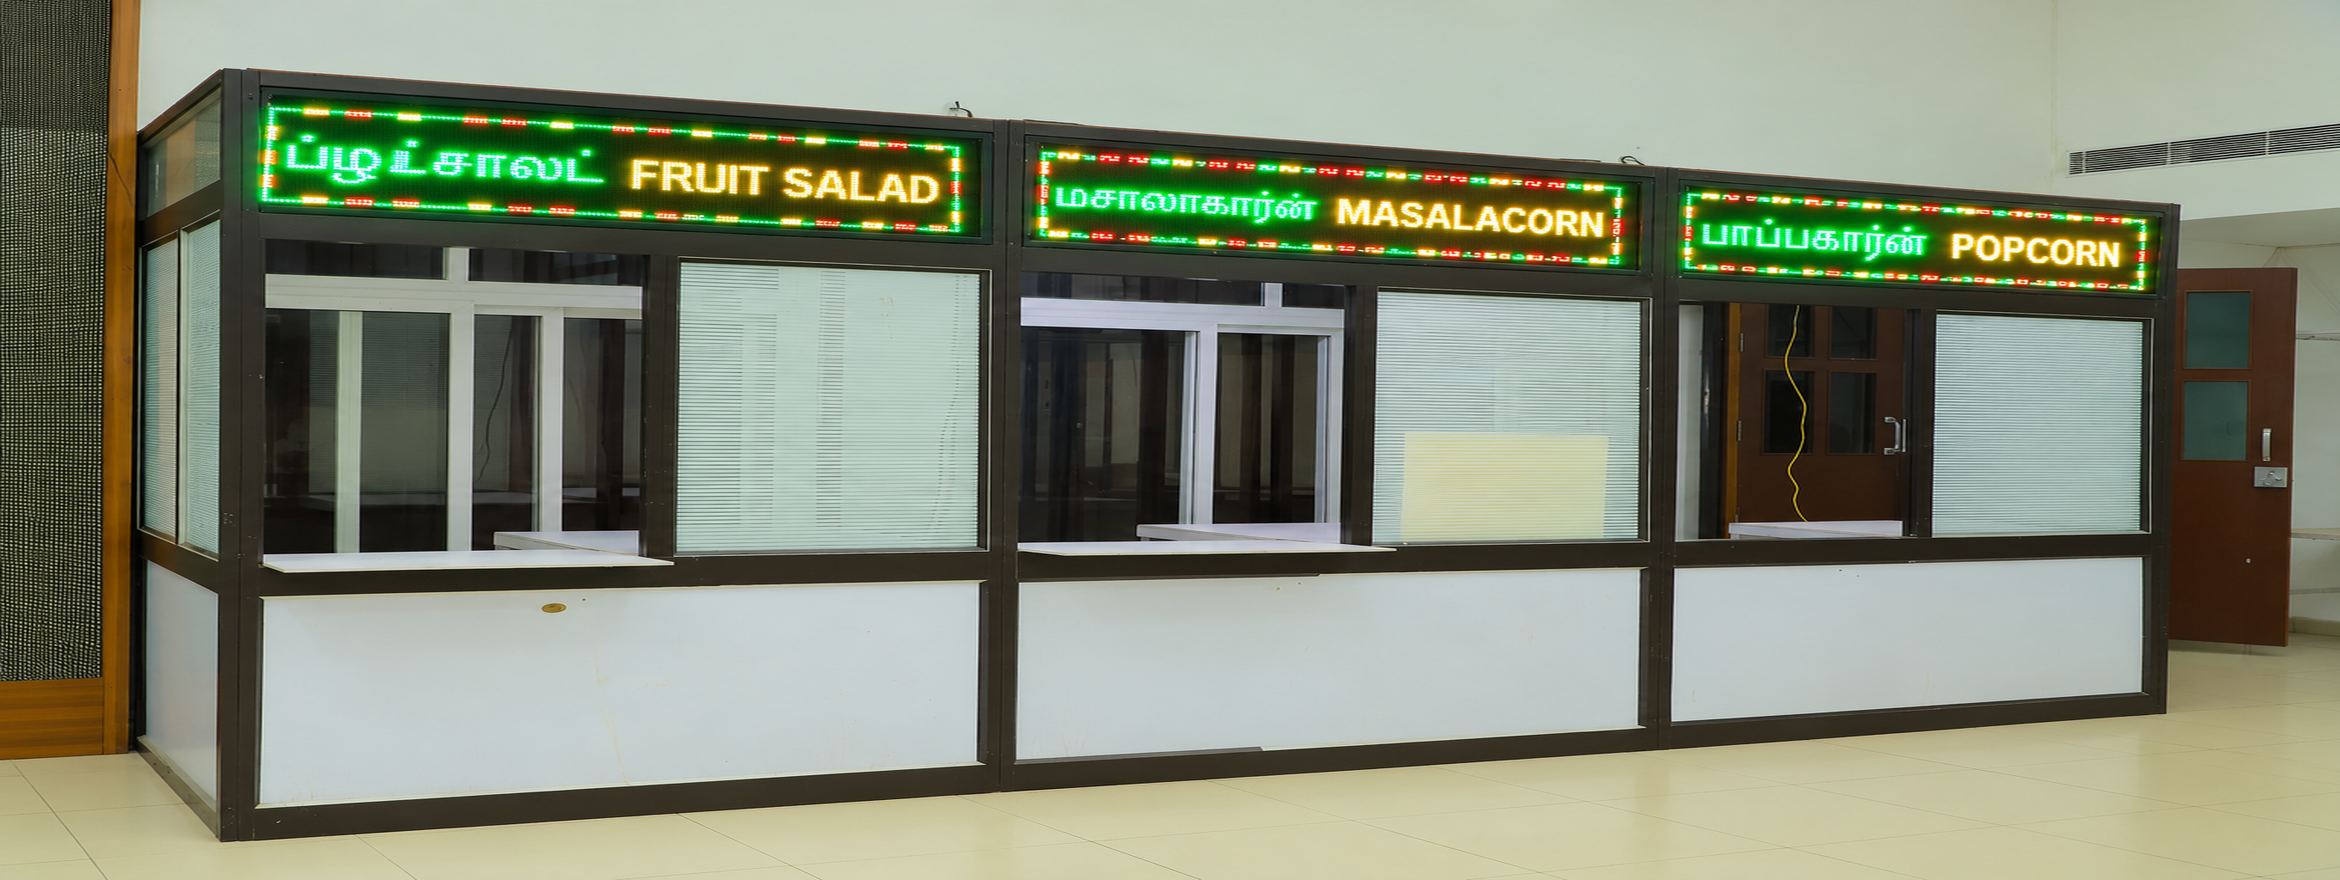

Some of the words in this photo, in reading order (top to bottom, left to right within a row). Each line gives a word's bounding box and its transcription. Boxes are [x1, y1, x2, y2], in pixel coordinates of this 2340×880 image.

[630, 159, 769, 197] FRUIT
[783, 167, 939, 204] SALAD
[1055, 187, 1318, 224] மசாலாகார்ன்
[1336, 199, 1605, 239] MASALACORN
[1702, 217, 1927, 262] பாப்பகார்ன்
[1951, 232, 2122, 268] POPCORN
